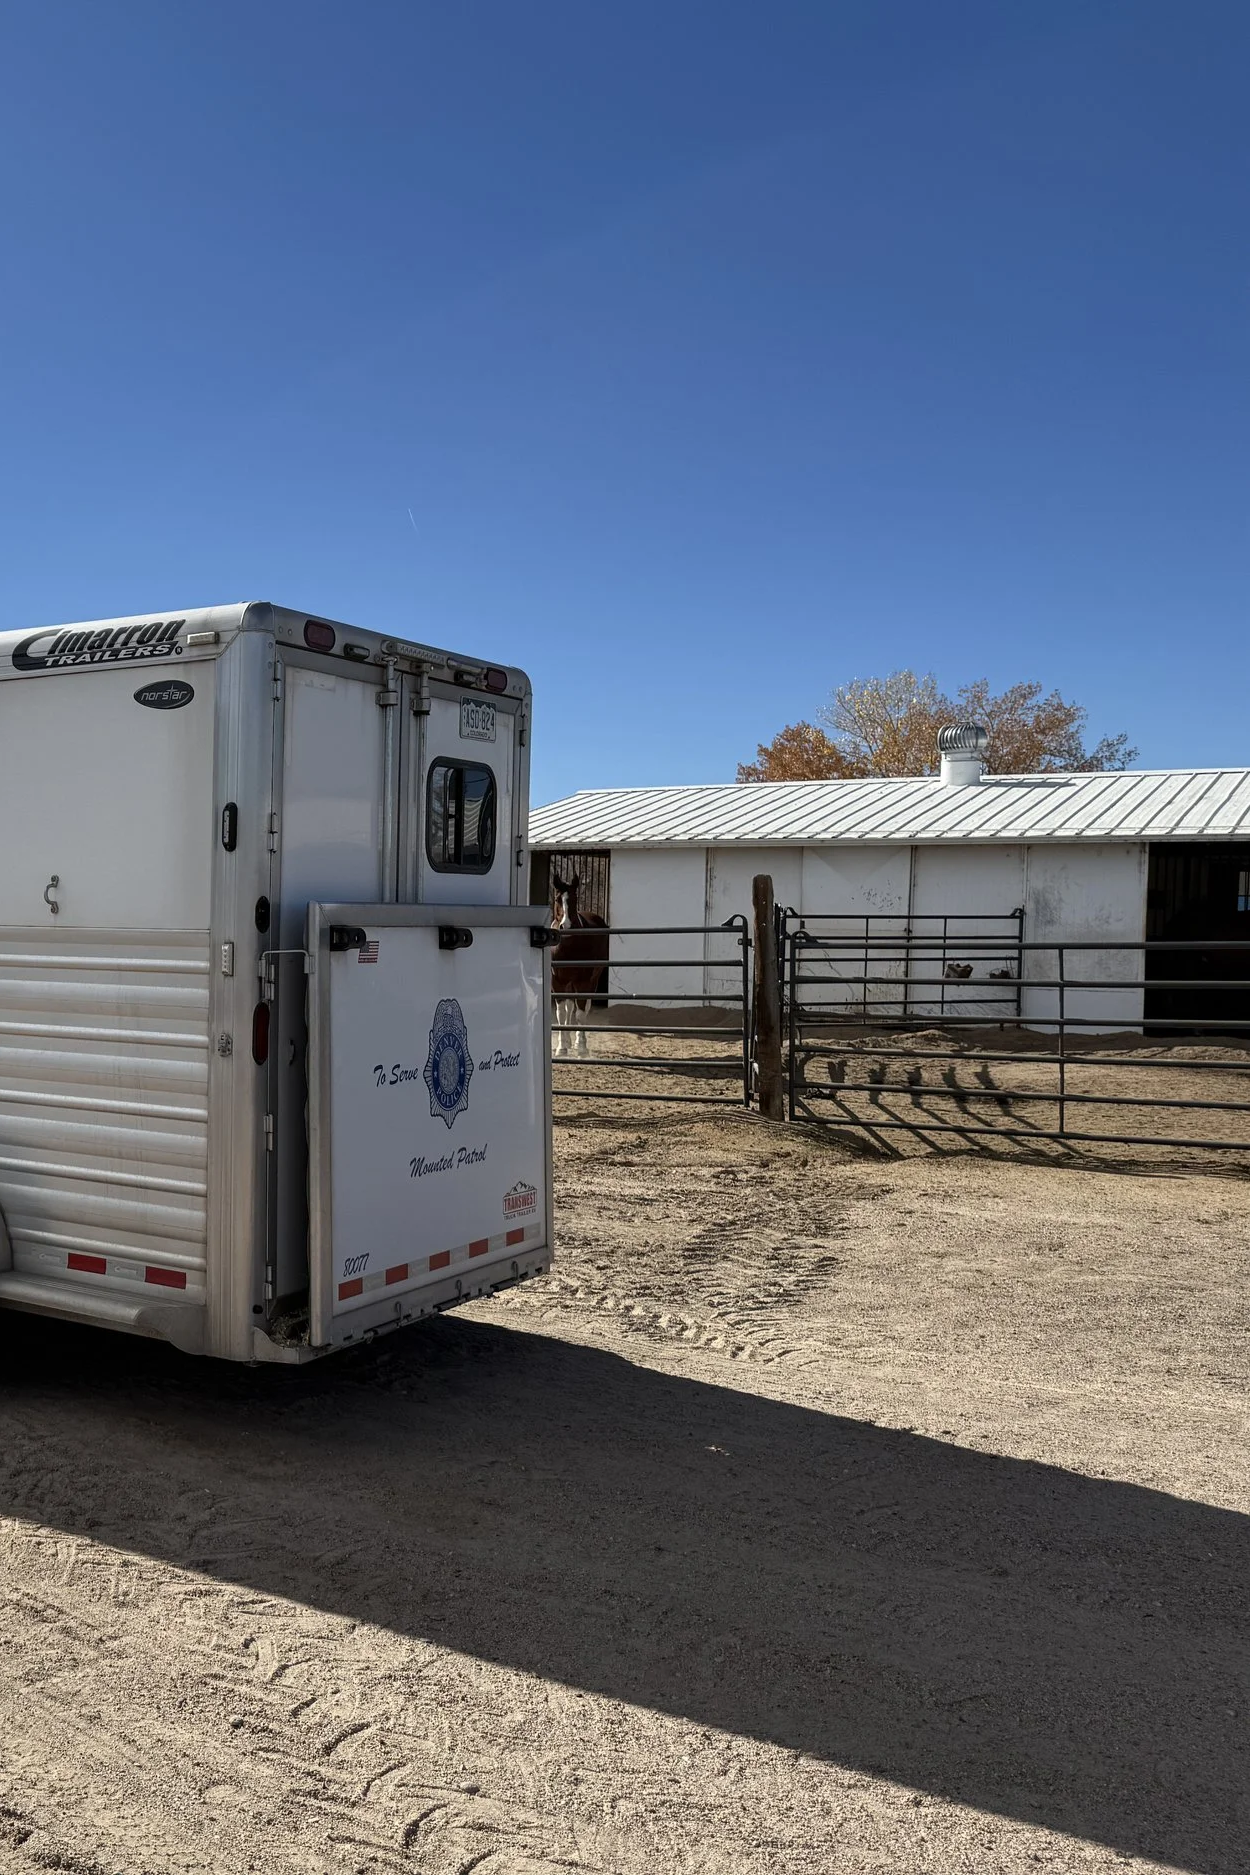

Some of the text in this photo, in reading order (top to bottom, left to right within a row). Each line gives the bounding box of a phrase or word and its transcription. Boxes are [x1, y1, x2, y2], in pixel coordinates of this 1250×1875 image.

[12, 619, 186, 671] Cimarron
[45, 644, 171, 666] TRAILERS
[141, 684, 188, 701] norstar
[479, 1050, 521, 1071] and Protect
[373, 1063, 418, 1087] To Serve
[410, 1143, 487, 1178] Mounted Patrol
[504, 1191, 536, 1212] TRANSWEST
